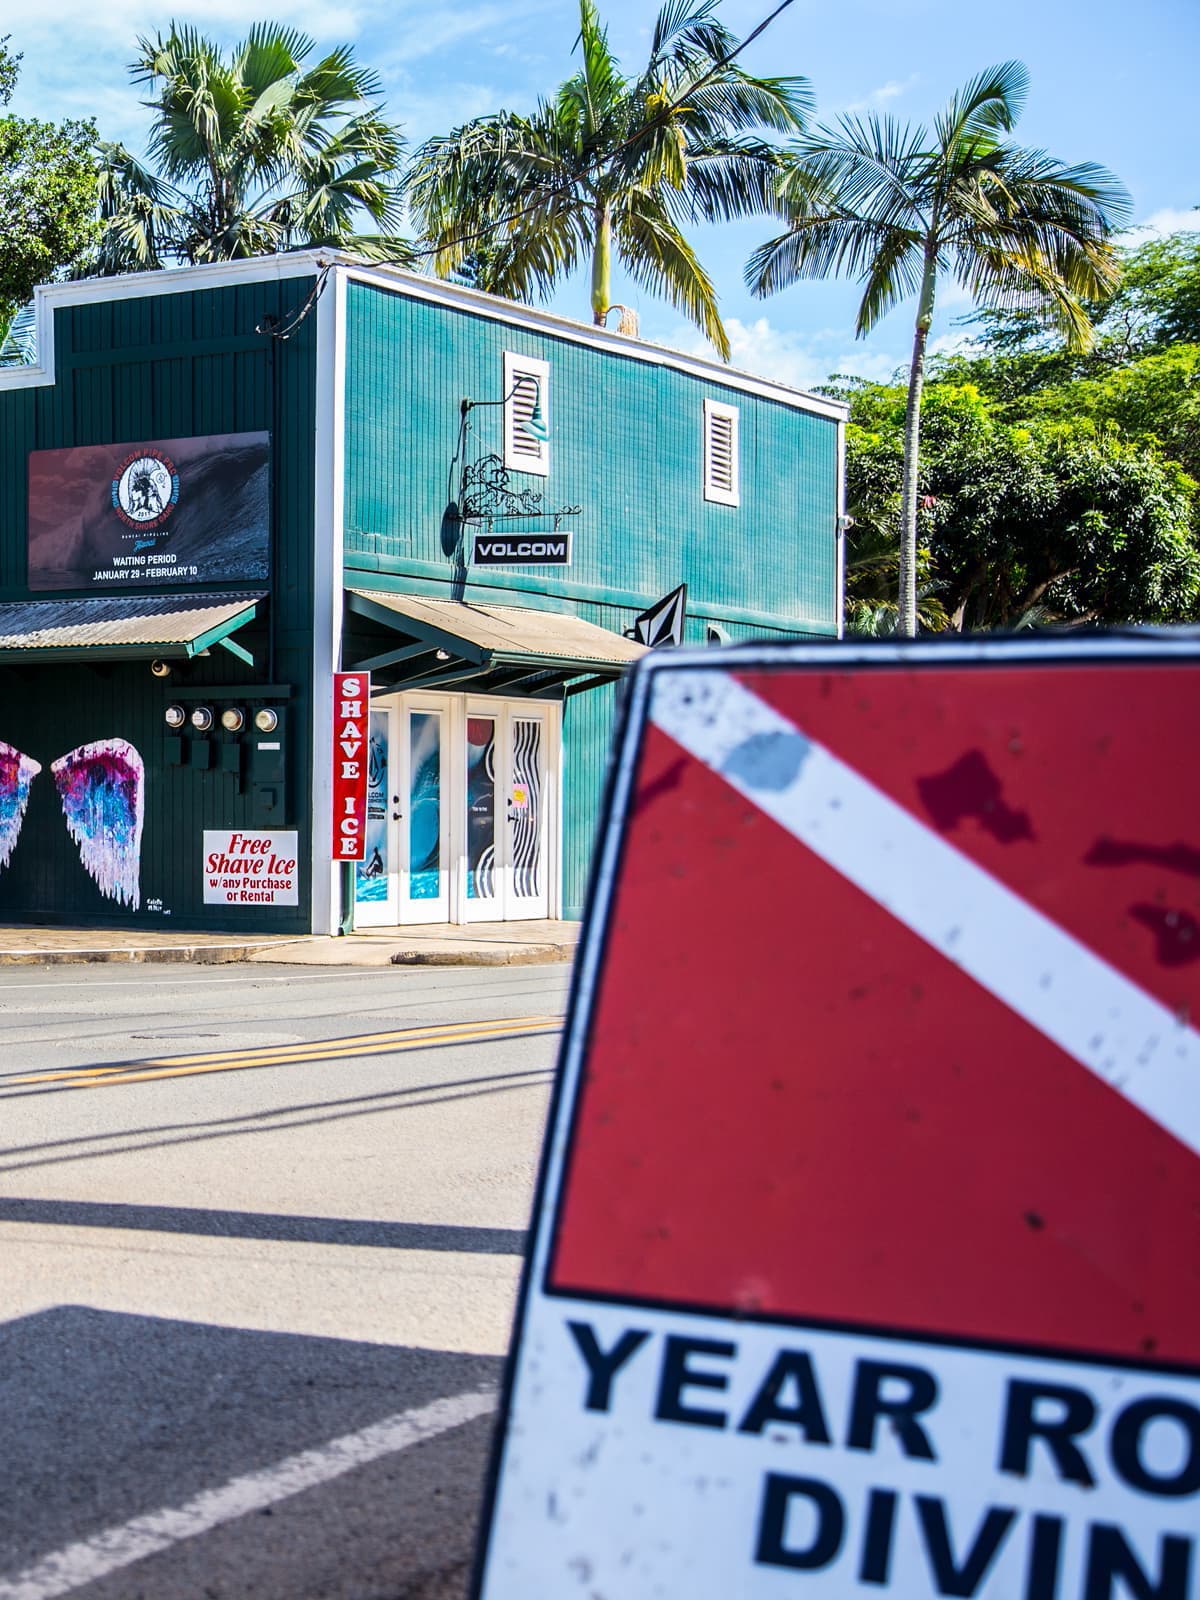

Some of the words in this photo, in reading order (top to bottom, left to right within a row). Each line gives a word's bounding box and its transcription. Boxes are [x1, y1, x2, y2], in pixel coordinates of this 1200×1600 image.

[113, 556, 145, 566] WAITING
[147, 554, 177, 564] PERIOD
[477, 543, 565, 556] VOLCOM
[93, 570, 129, 580] JANUARY
[131, 569, 140, 579] 29
[146, 567, 188, 578] FEBRUARY
[189, 566, 198, 575] 10
[340, 678, 363, 779] SHAVE
[340, 797, 359, 855] ICE
[228, 833, 272, 854] Free
[206, 853, 264, 874] Shave
[267, 854, 296, 875] Ice
[210, 877, 240, 889] w/any
[243, 877, 292, 889] Purchase
[227, 892, 238, 901] or
[240, 890, 274, 902] Rental
[564, 1319, 941, 1464] YEAR
[996, 1376, 1200, 1501] RO
[752, 1470, 1196, 1600] DIVIN
